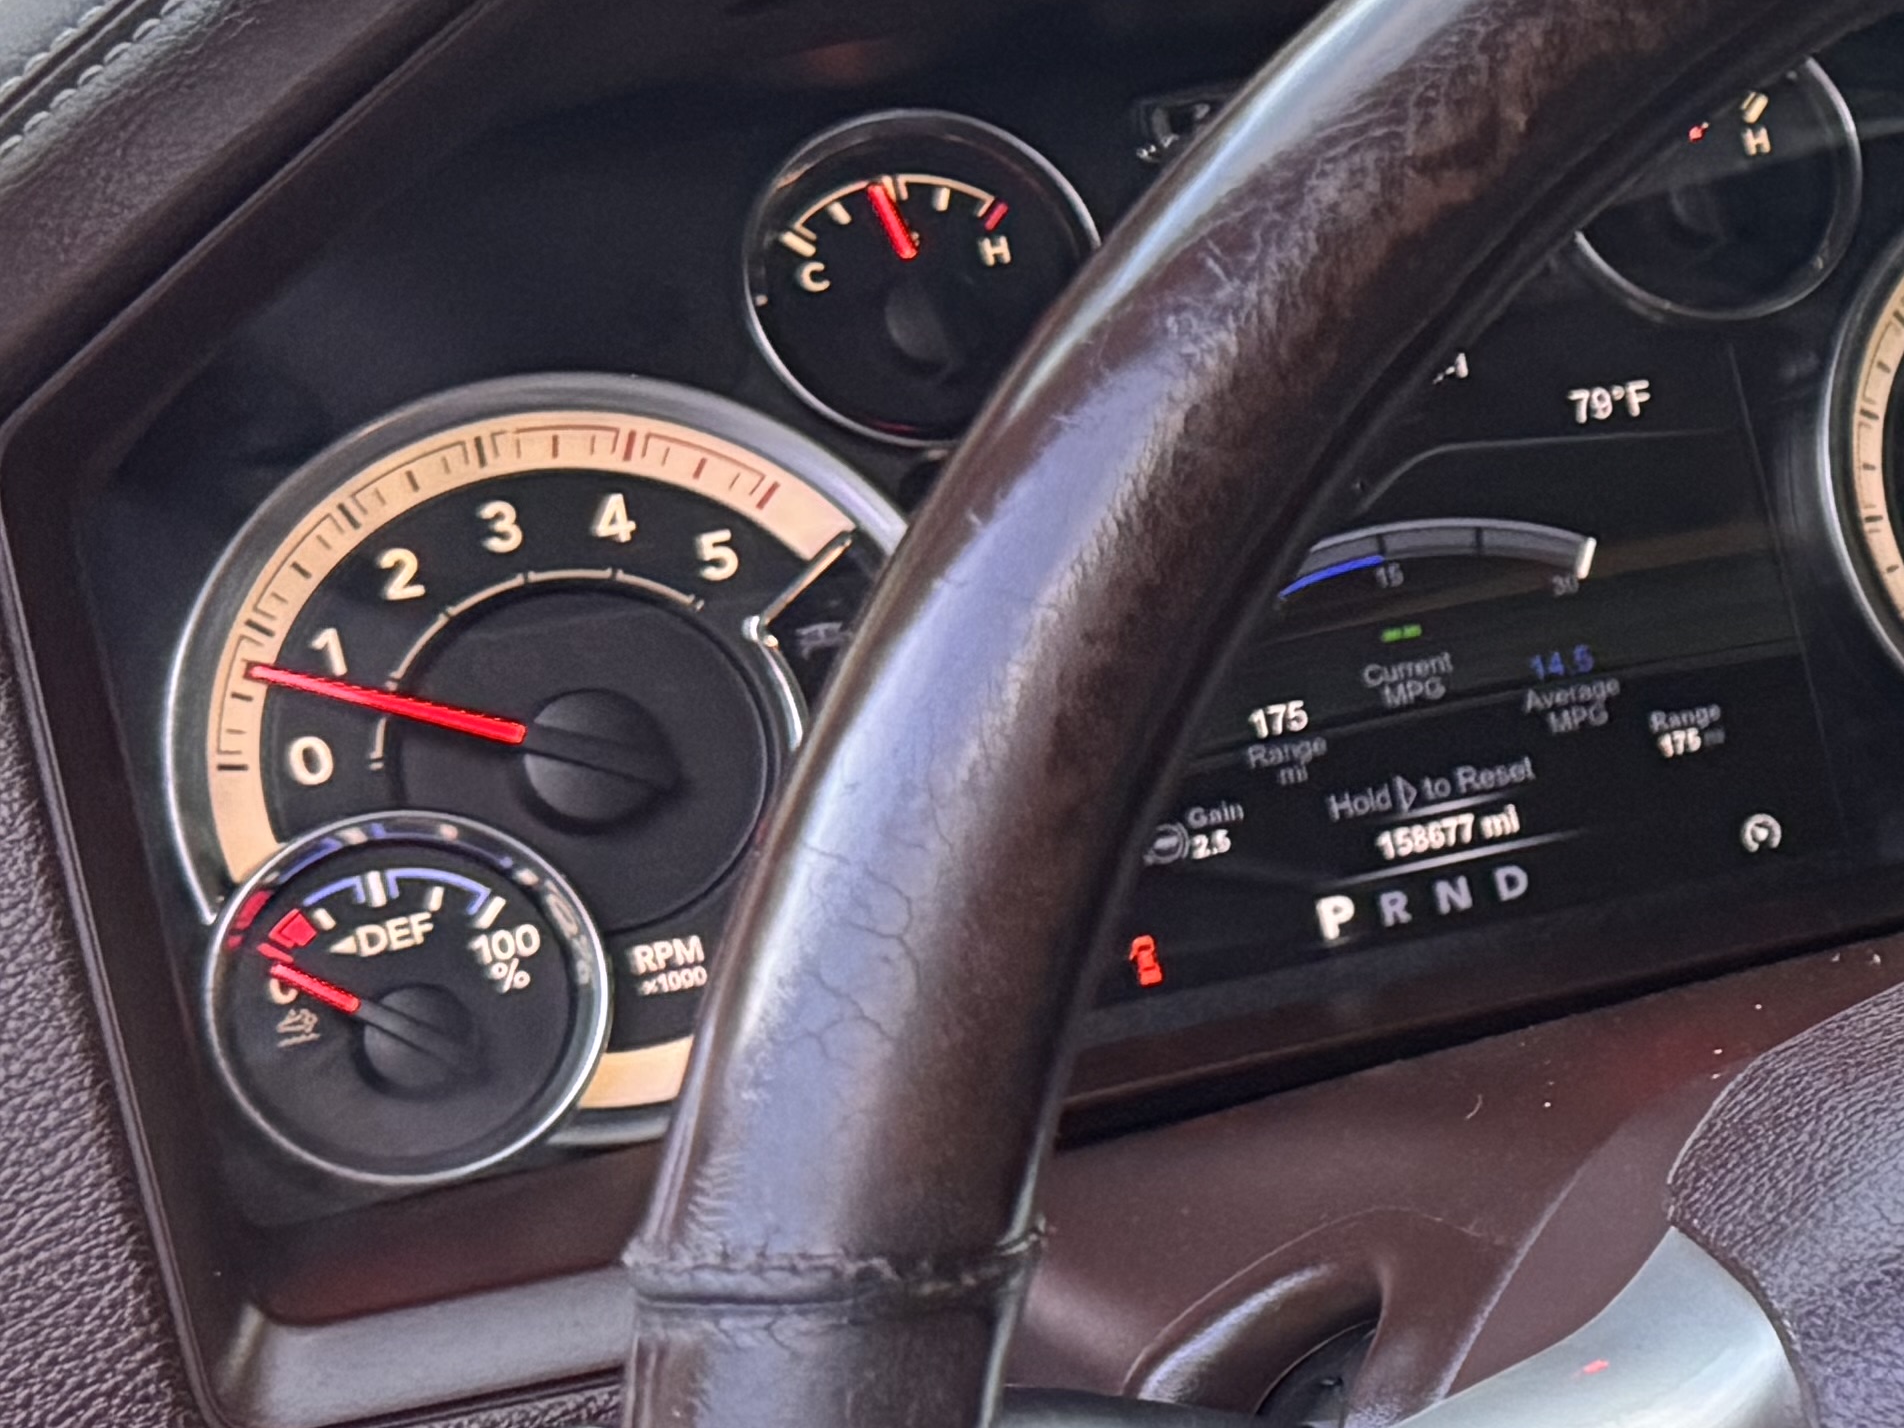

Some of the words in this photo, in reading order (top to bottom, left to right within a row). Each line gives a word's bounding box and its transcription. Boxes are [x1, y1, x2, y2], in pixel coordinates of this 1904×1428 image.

[1742, 125, 1772, 157] H
[980, 237, 1011, 267] H
[800, 262, 830, 293] C
[1567, 379, 1651, 424] 79°F
[480, 501, 525, 552] 3
[591, 493, 635, 544] 4
[698, 529, 739, 581] 5
[381, 548, 425, 602] 2
[311, 627, 348, 675] 1
[1363, 652, 1454, 688] Current
[1531, 644, 1594, 680] 14.5
[1382, 677, 1447, 709] MPG
[1523, 678, 1621, 715] Average
[1248, 700, 1308, 740] 175
[1547, 706, 1609, 736] MPG
[1649, 704, 1722, 732] Range
[289, 737, 334, 785] 0
[1247, 735, 1328, 771] Range
[1658, 730, 1701, 758] 175
[1327, 790, 1393, 822] Hold
[1422, 775, 1452, 801] to
[1454, 756, 1536, 795] Reset
[1186, 801, 1245, 827] Gain
[1374, 813, 1475, 861] 158677
[1479, 804, 1521, 840] mi
[1190, 829, 1231, 861] 2.5
[1315, 894, 1354, 941] P
[1379, 890, 1412, 927] R
[1434, 875, 1472, 915] N
[1492, 865, 1529, 902] D
[356, 912, 434, 956] DEF
[470, 924, 540, 966] 100
[630, 935, 705, 974] RPM
[489, 959, 531, 994] %
